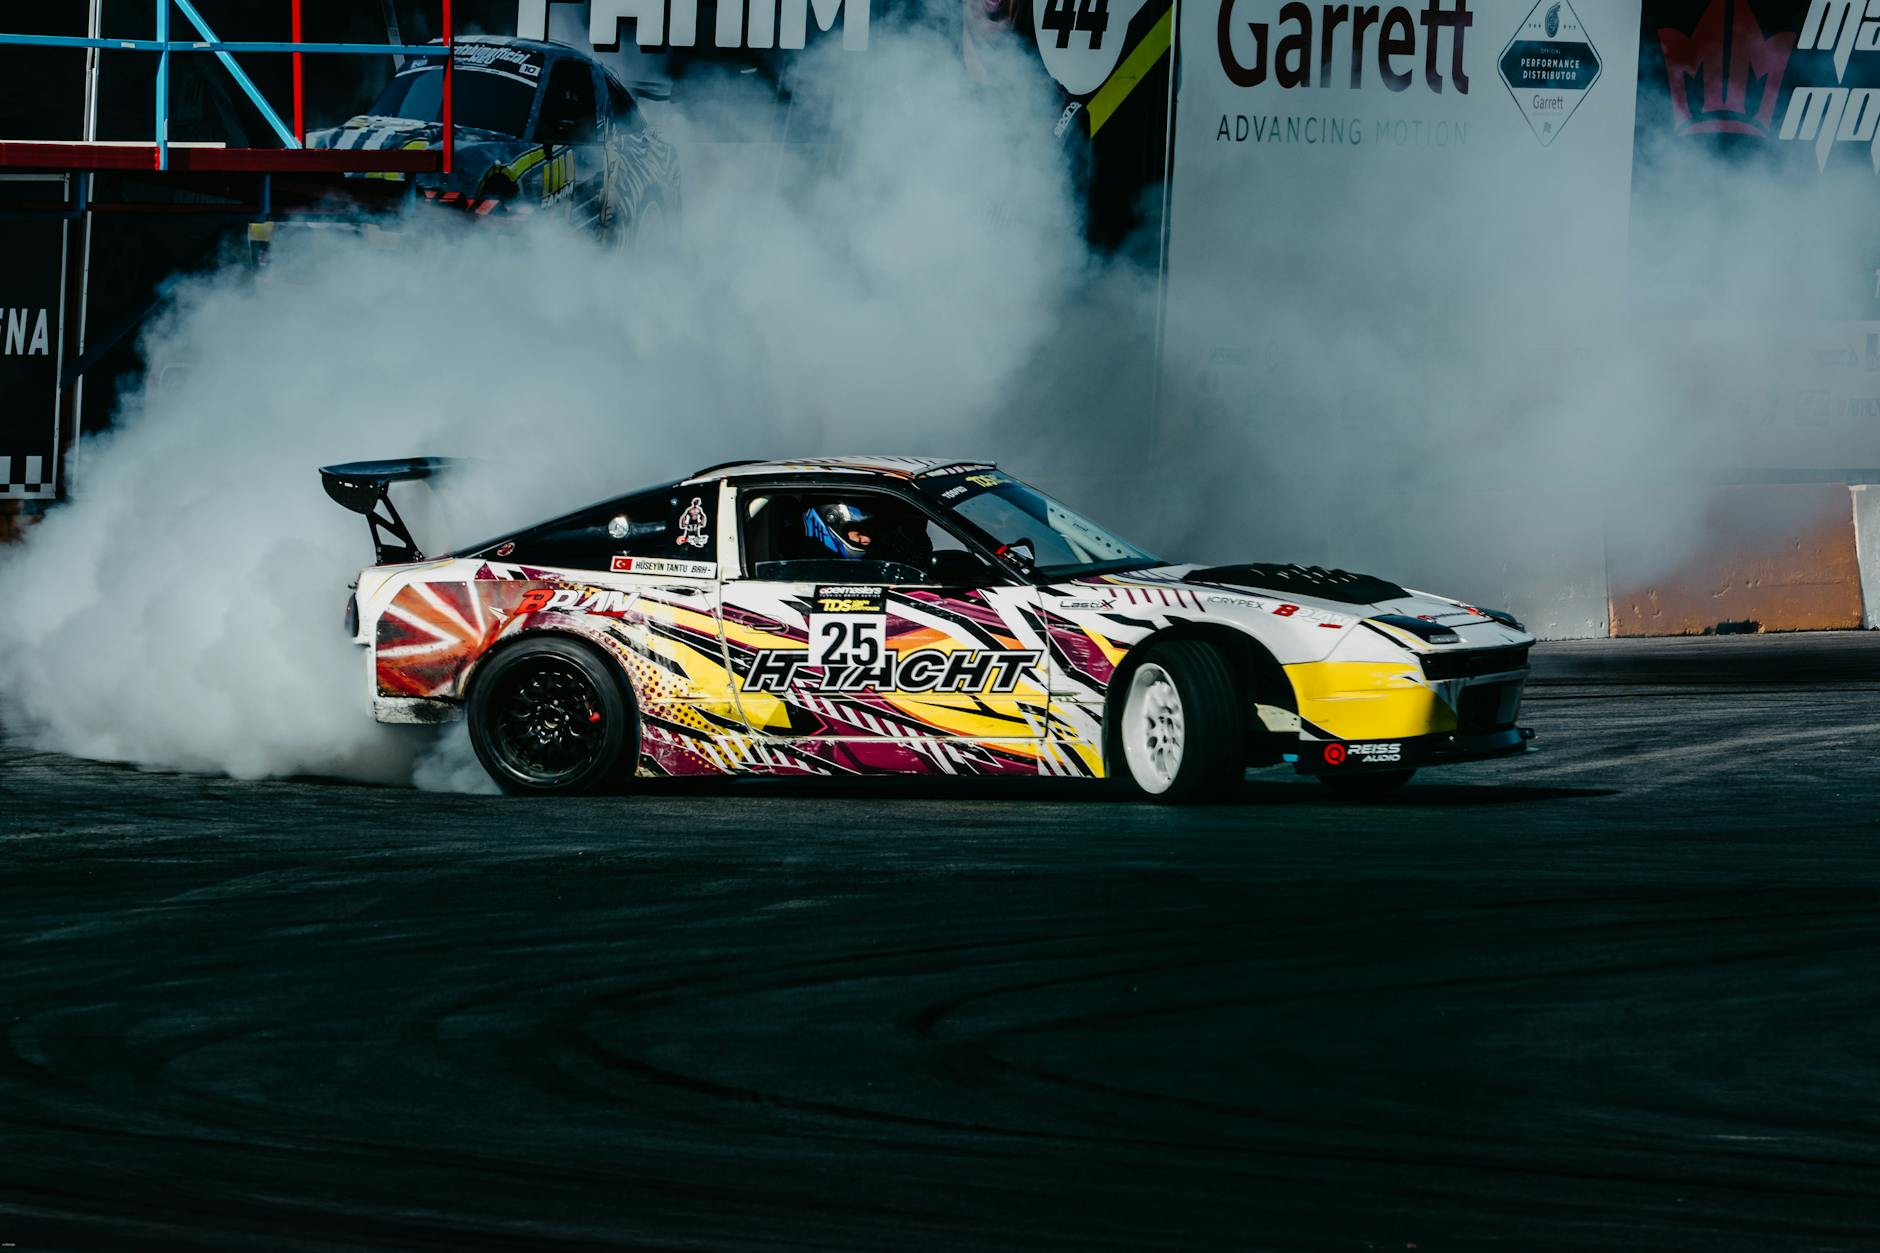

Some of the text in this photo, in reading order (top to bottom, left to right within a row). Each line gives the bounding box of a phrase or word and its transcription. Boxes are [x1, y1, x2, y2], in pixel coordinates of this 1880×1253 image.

[1042, 0, 1109, 50] 44
[1217, 0, 1474, 95] Garrett
[1520, 58, 1580, 69] PERFORMANCE
[1522, 70, 1577, 80] DISTRIBUTOR
[1532, 94, 1564, 110] Garrett
[1216, 115, 1468, 147] ADVANCING MOTION
[0, 307, 49, 356] NA
[666, 563, 688, 573] TANTU
[817, 598, 852, 612] TDS
[821, 622, 879, 667] 25
[1347, 743, 1402, 755] REISS
[1361, 754, 1401, 763] AUDIO
